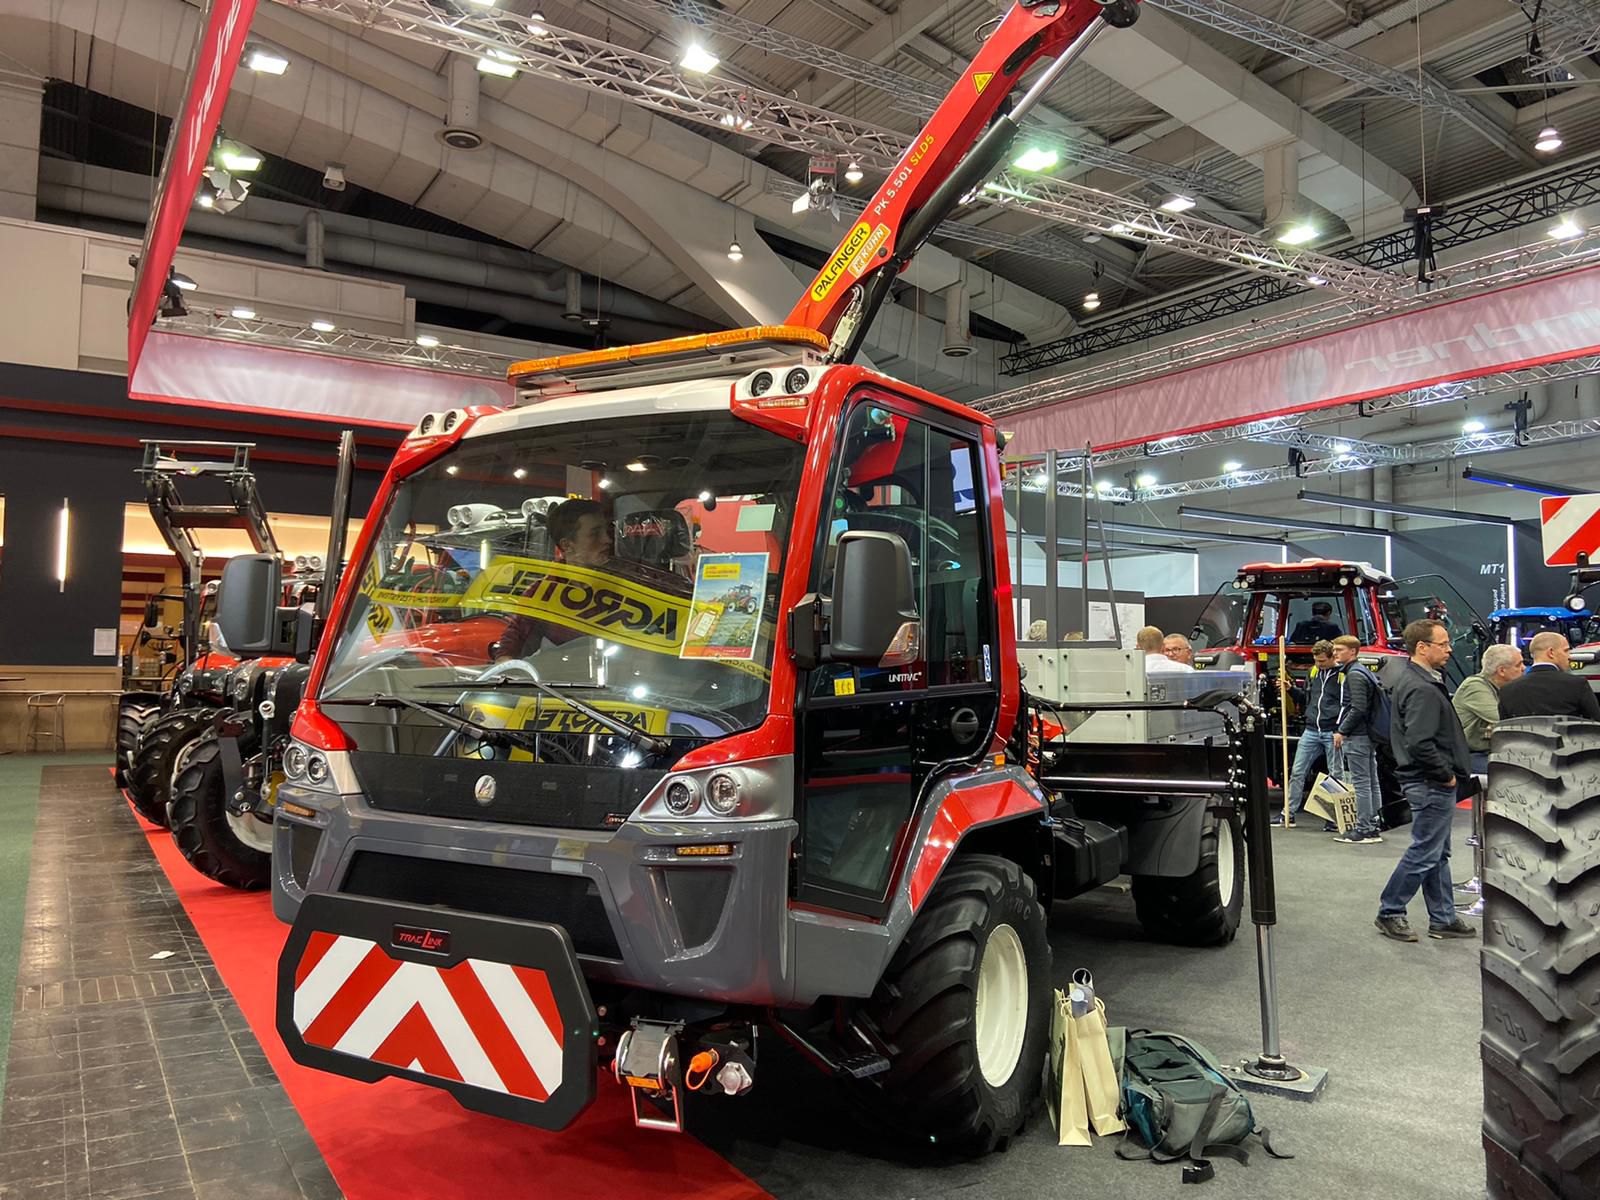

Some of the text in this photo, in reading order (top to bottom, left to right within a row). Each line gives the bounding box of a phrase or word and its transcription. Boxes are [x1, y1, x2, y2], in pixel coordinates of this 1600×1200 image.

[873, 198, 890, 216] PK
[886, 166, 913, 199] 5.501
[861, 228, 885, 260] KUHN
[814, 226, 868, 298] PALFINGER
[1480, 563, 1505, 575] MT1
[888, 671, 922, 683] UNITRAC
[1340, 796, 1356, 805] NOT
[1341, 804, 1358, 815] RU
